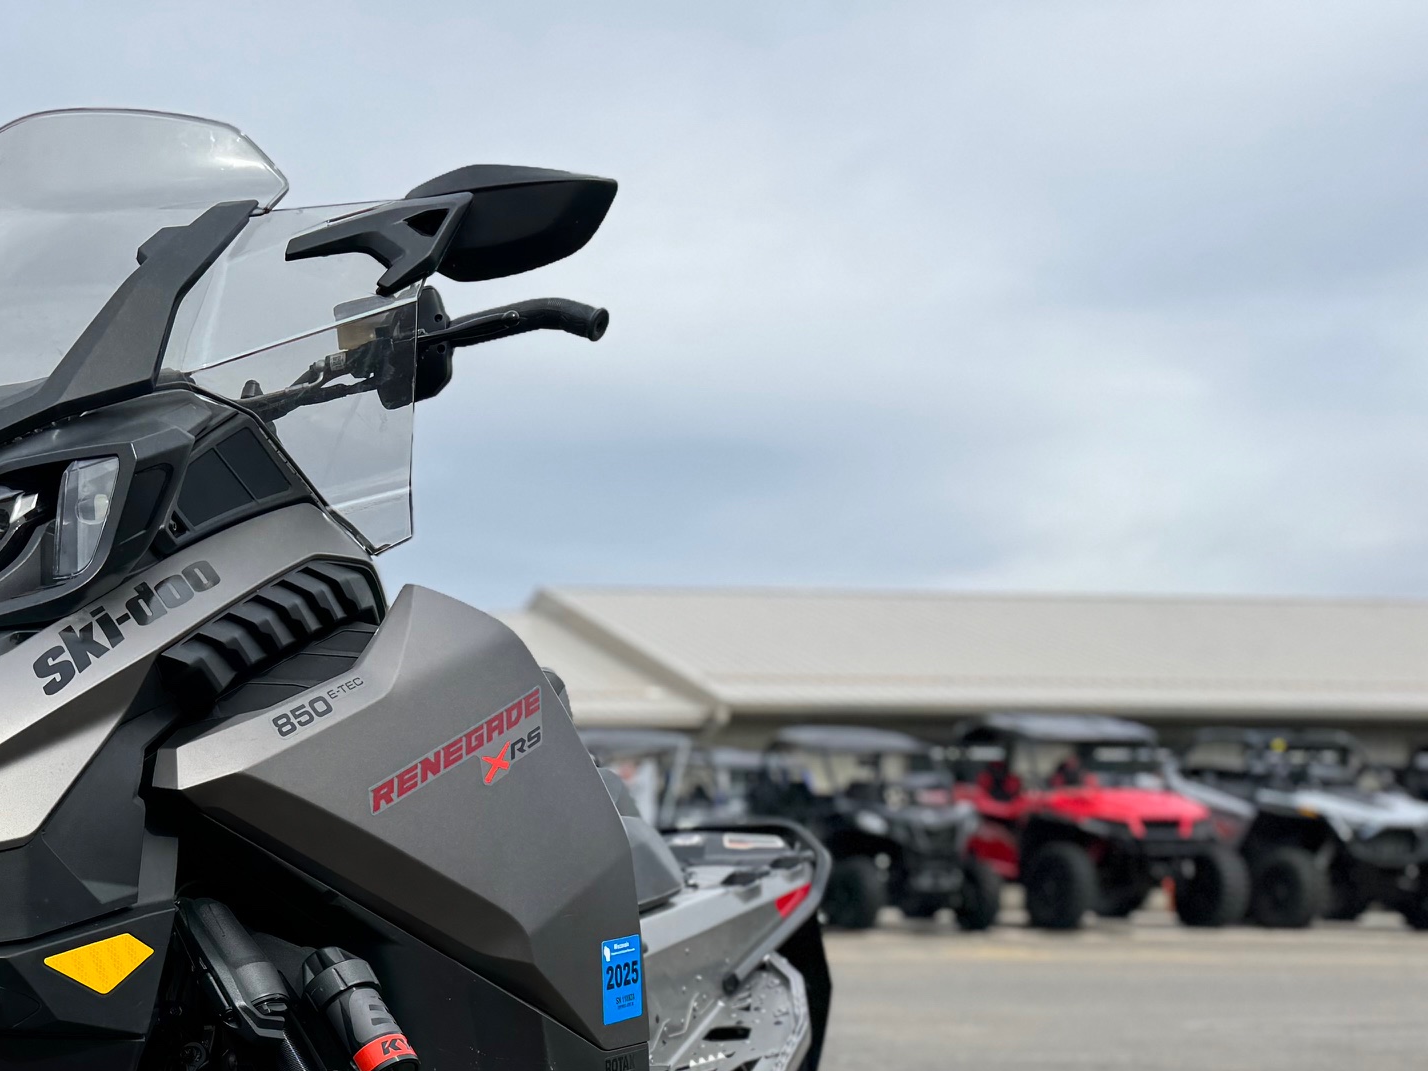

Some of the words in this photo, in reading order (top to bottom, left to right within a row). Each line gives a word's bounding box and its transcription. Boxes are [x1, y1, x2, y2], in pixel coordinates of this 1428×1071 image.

[272, 695, 334, 737] 850
[327, 677, 364, 700] E-TEC
[372, 688, 542, 814] RENEGADE
[606, 960, 639, 990] 2025
